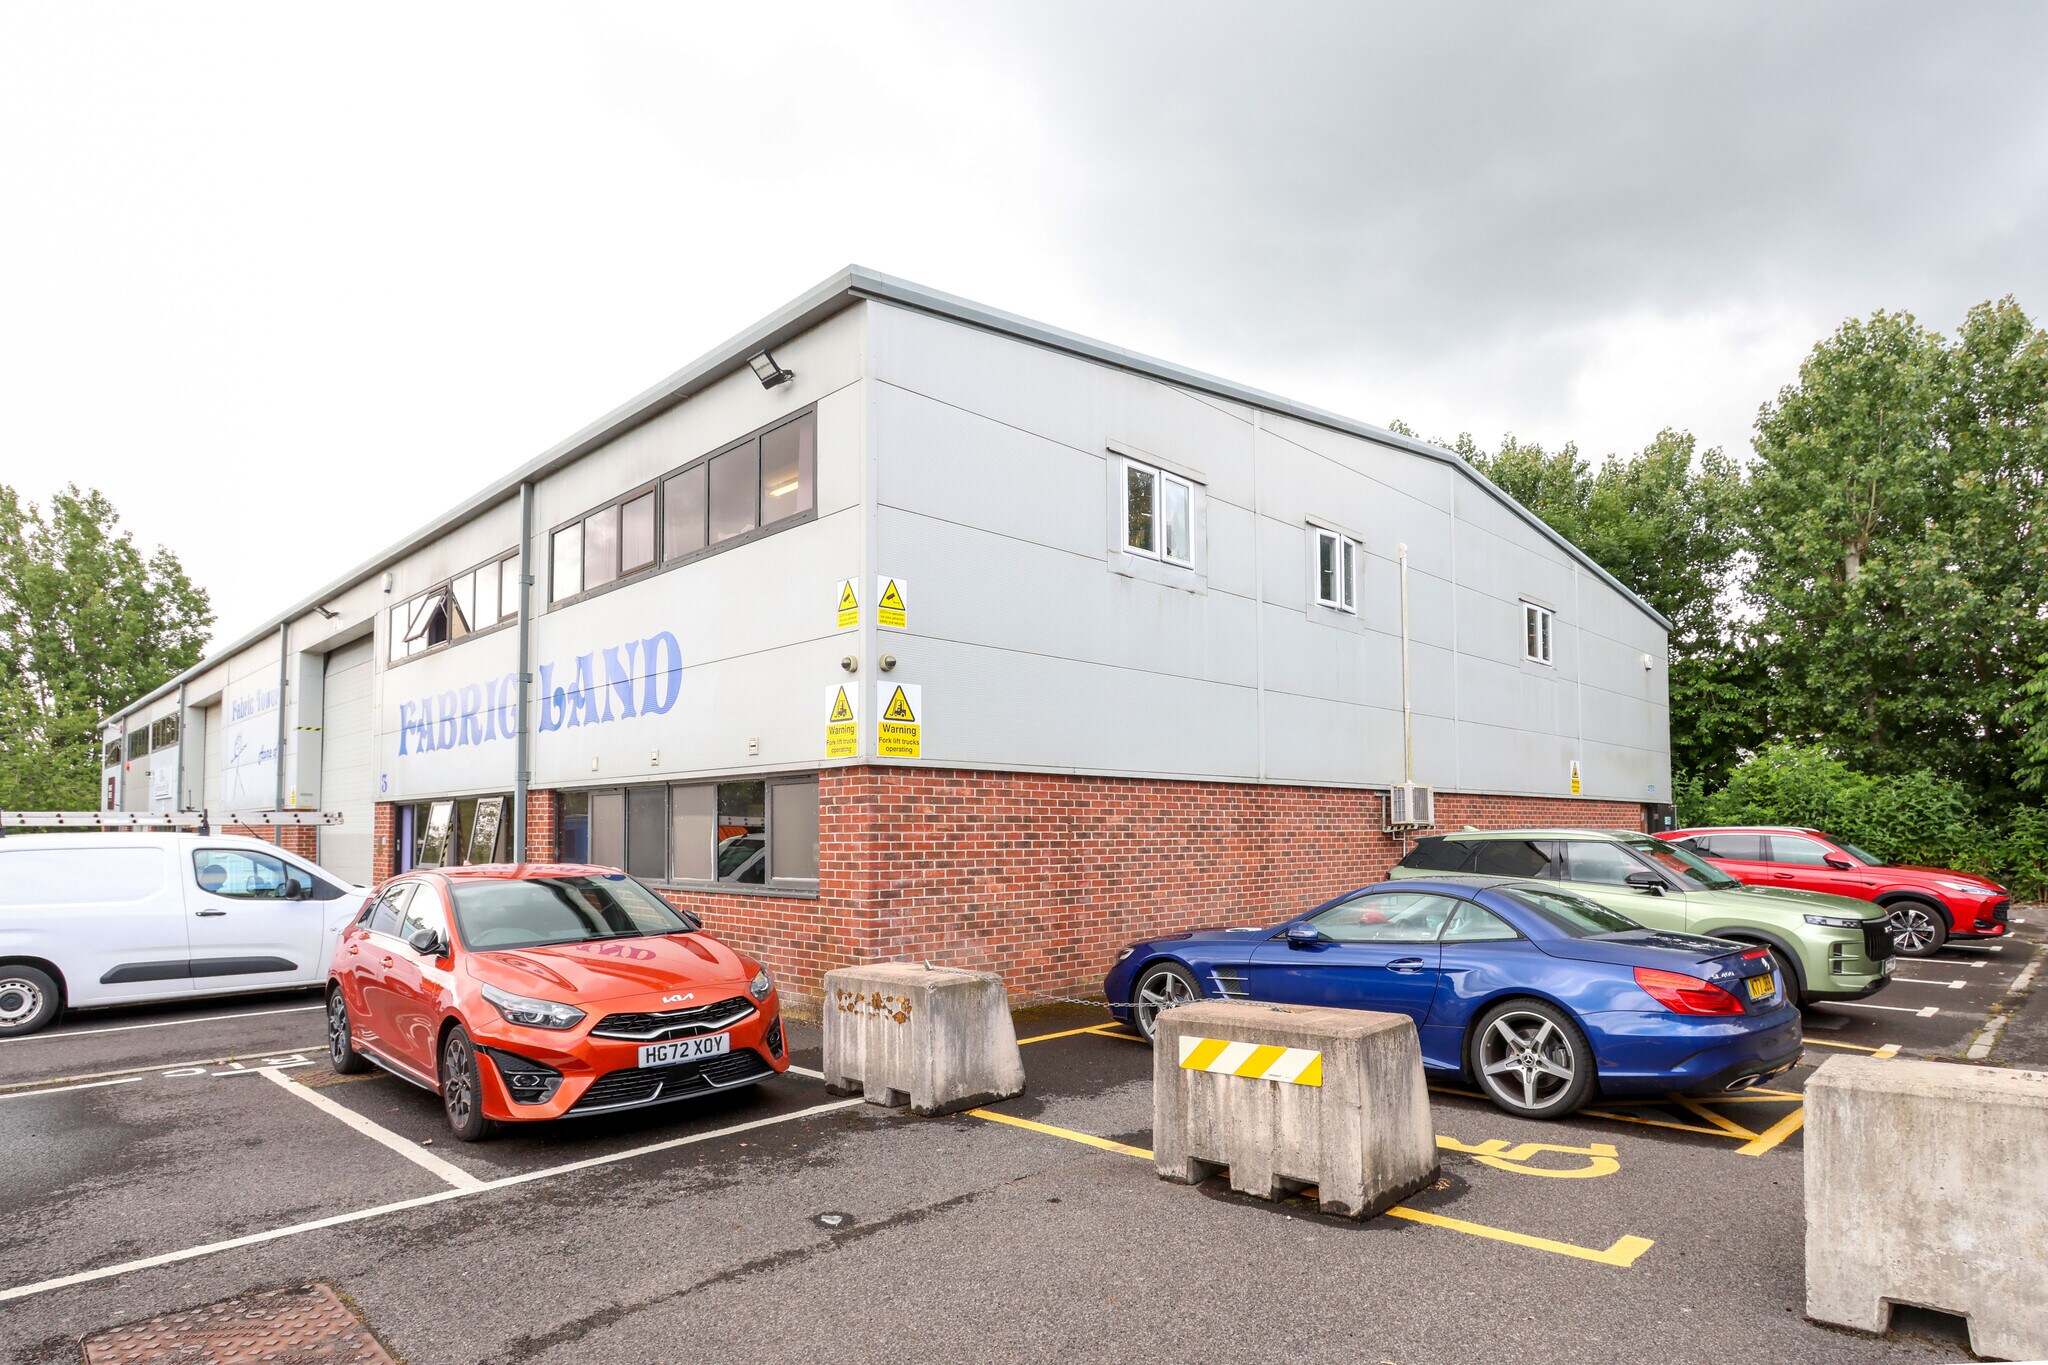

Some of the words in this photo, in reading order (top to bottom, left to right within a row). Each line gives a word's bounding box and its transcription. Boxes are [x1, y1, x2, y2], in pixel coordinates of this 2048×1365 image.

[538, 630, 683, 733] LAND
[828, 725, 854, 736] Warning
[882, 724, 917, 736] Warning
[885, 746, 913, 754] operating
[381, 773, 388, 793] 3
[646, 1042, 689, 1064] HG72
[694, 1036, 723, 1056] XOY
